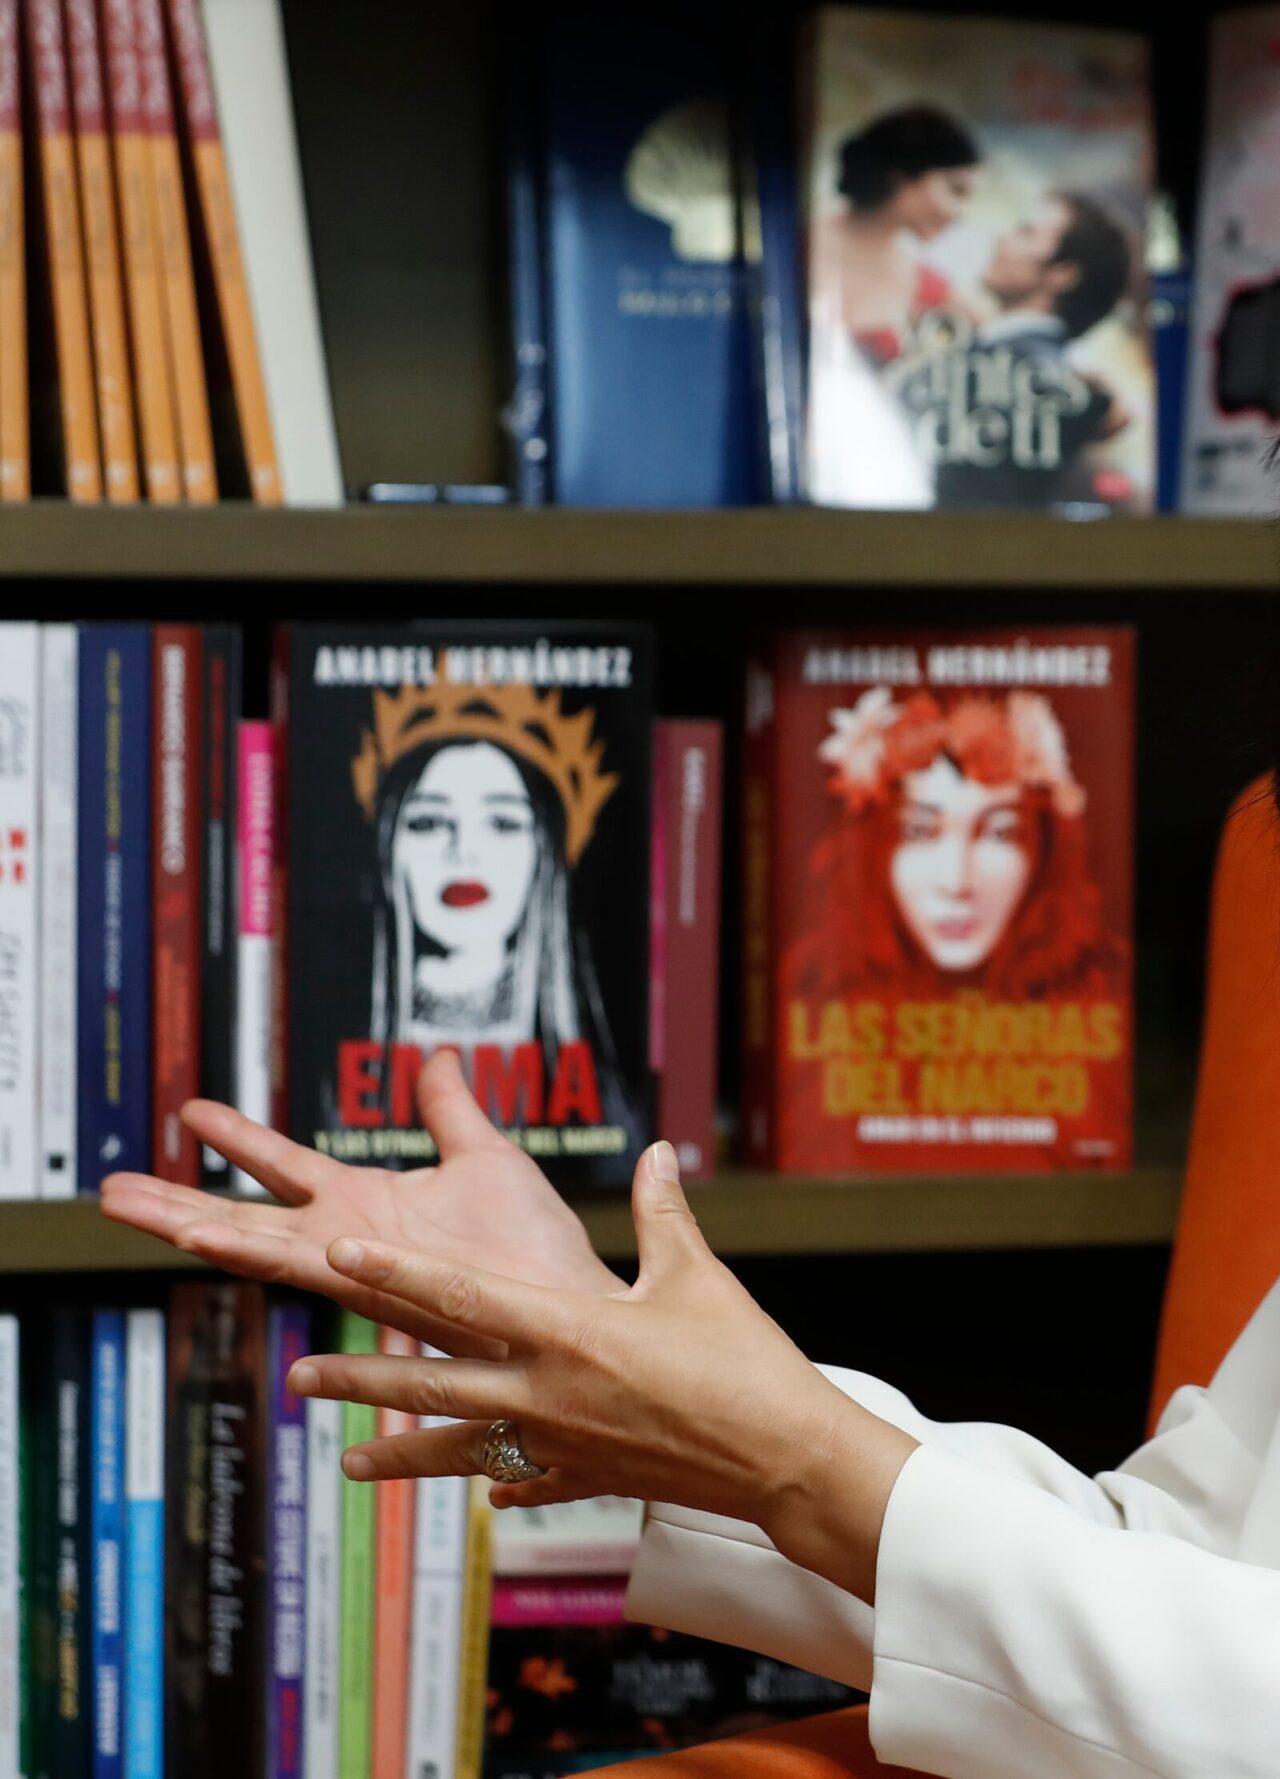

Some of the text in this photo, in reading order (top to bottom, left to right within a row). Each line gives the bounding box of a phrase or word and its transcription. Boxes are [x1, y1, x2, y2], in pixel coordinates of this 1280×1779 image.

[313, 638, 633, 688] ANABEL HERNÁNDEZ
[804, 637, 1112, 687] ANABEL HERNÁNDEZ
[790, 987, 1122, 1062] LAS SEÑORAS
[823, 1059, 1090, 1117] DEL NARCO
